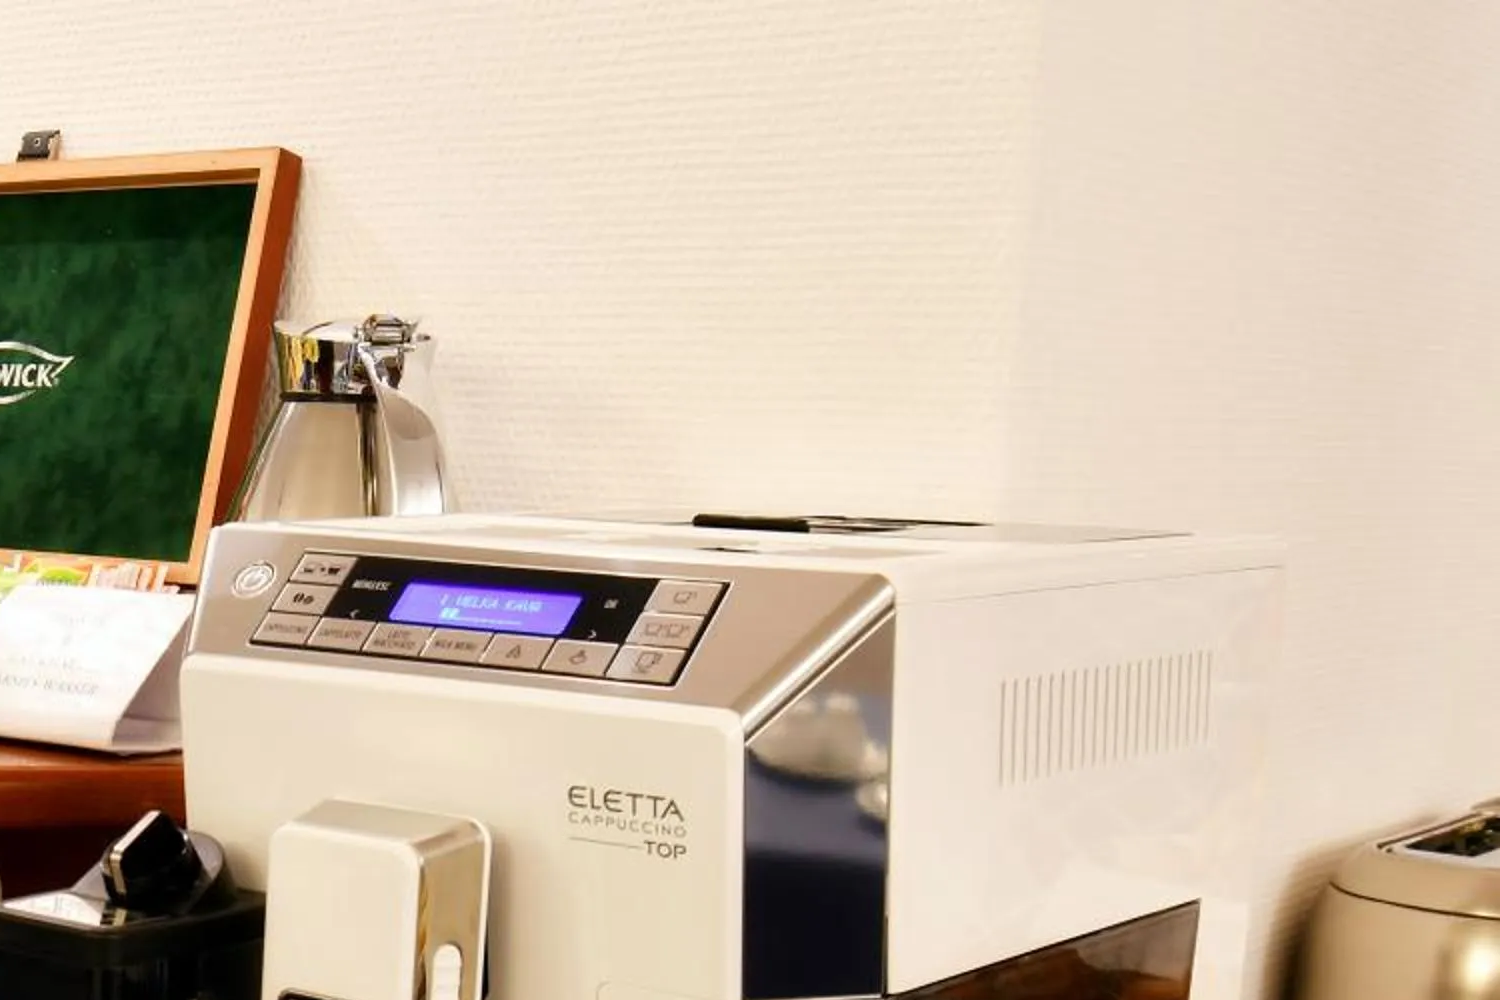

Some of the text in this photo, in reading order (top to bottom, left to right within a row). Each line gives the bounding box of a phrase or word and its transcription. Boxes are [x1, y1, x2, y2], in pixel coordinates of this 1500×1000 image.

[567, 785, 685, 822] ELETTA
[567, 811, 688, 839] CAPPUCCINO
[643, 839, 688, 859] TOP
